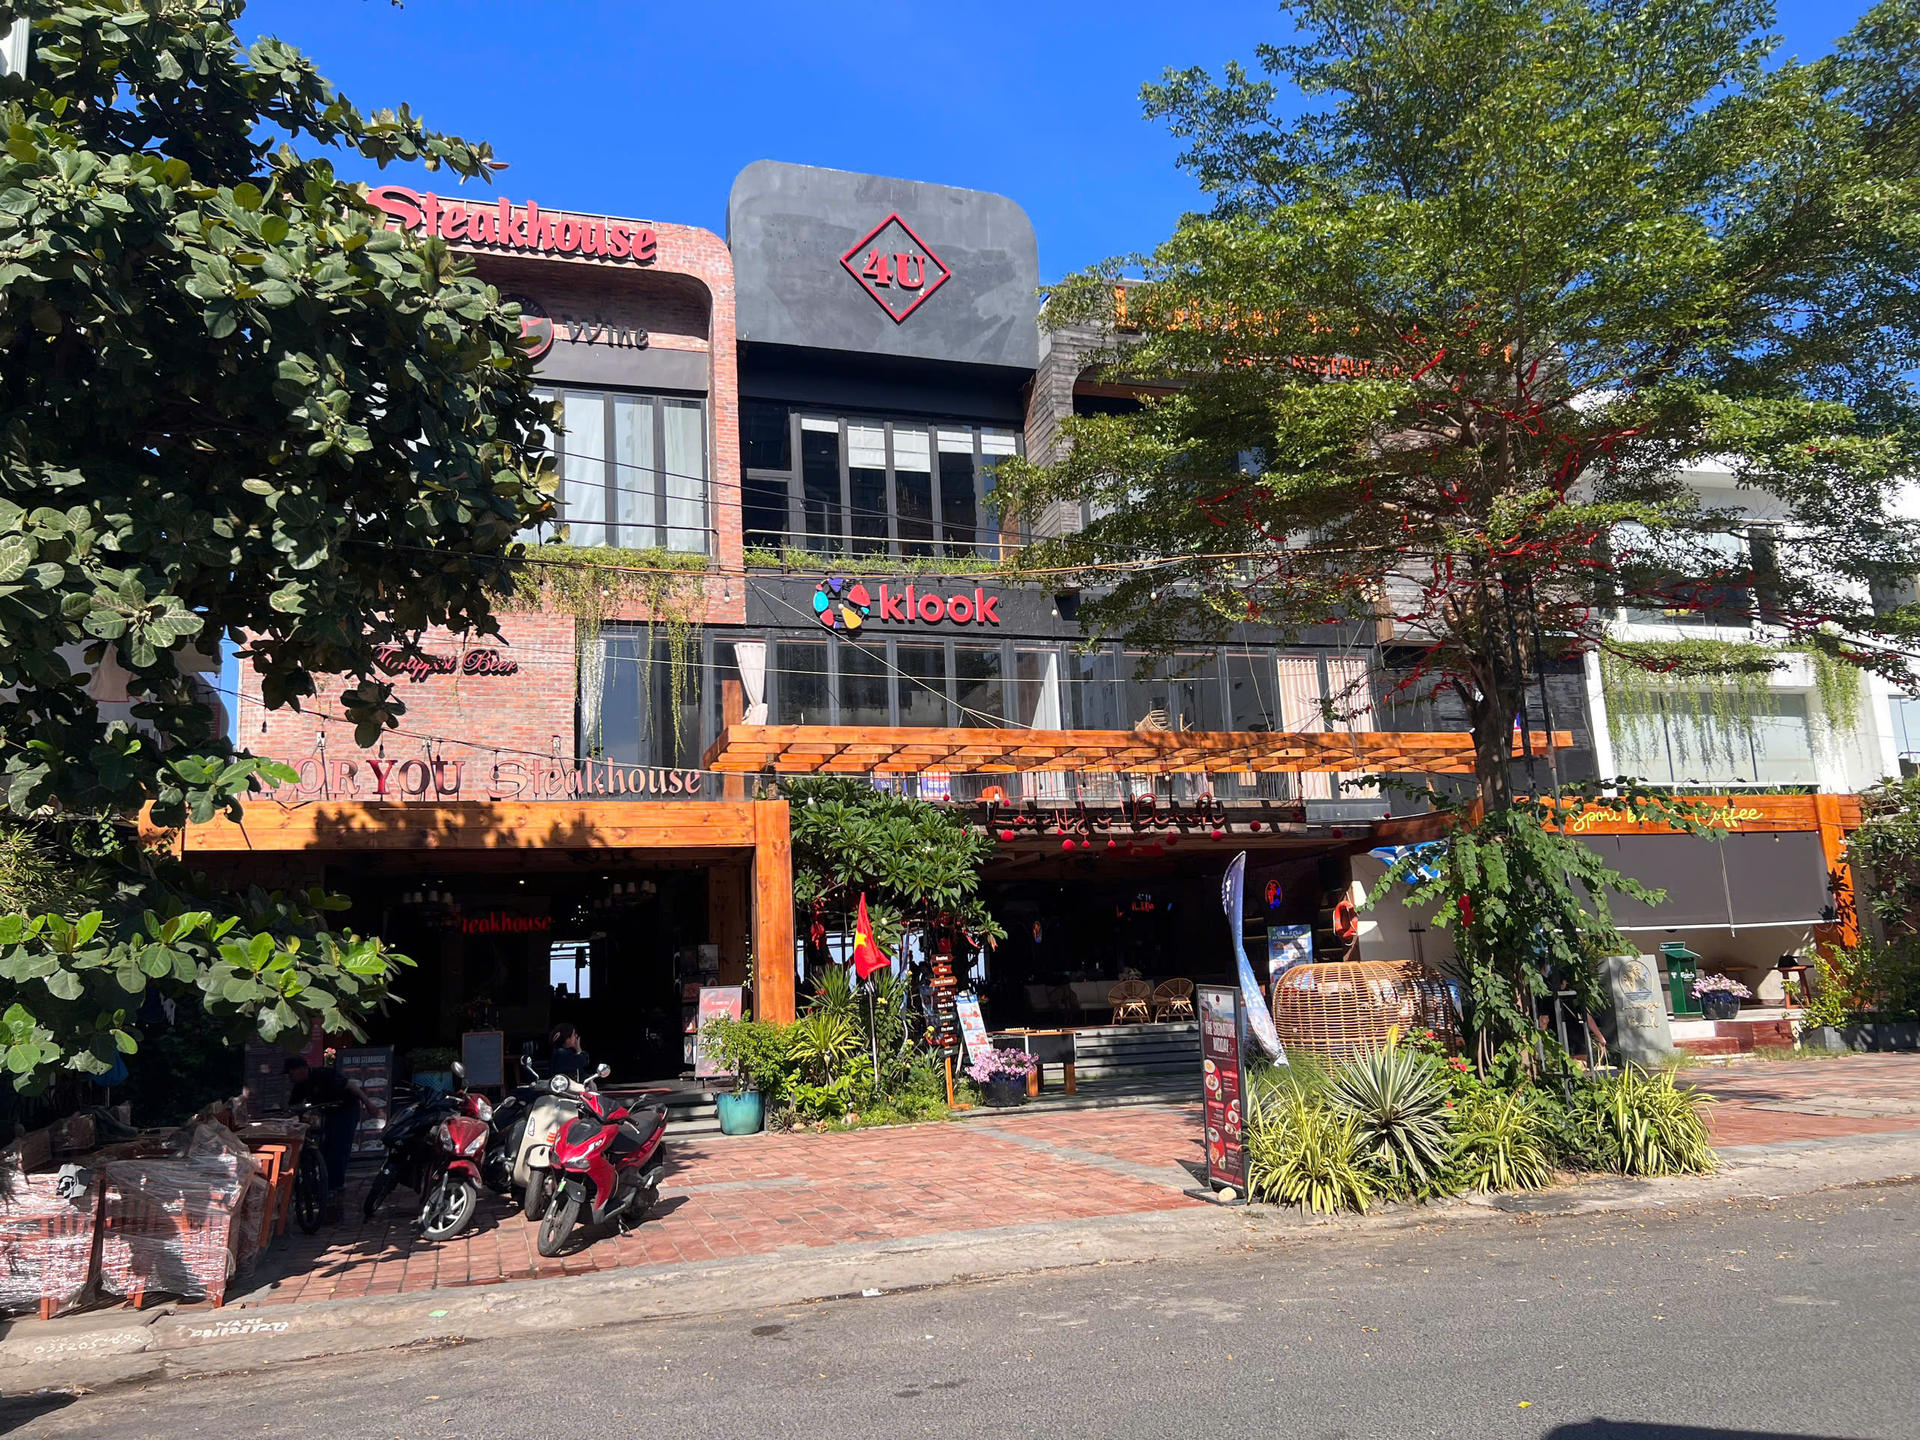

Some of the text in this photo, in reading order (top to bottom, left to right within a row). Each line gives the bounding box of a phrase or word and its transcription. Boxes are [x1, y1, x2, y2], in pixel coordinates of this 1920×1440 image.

[366, 185, 658, 262] Steakhouse
[862, 247, 926, 291] 4U
[565, 319, 649, 348] Wine
[879, 583, 1001, 625] klook
[463, 650, 519, 676] Beer
[365, 759, 466, 796] YOU
[487, 756, 702, 799] Steakhouse
[443, 908, 552, 934] teakhouse
